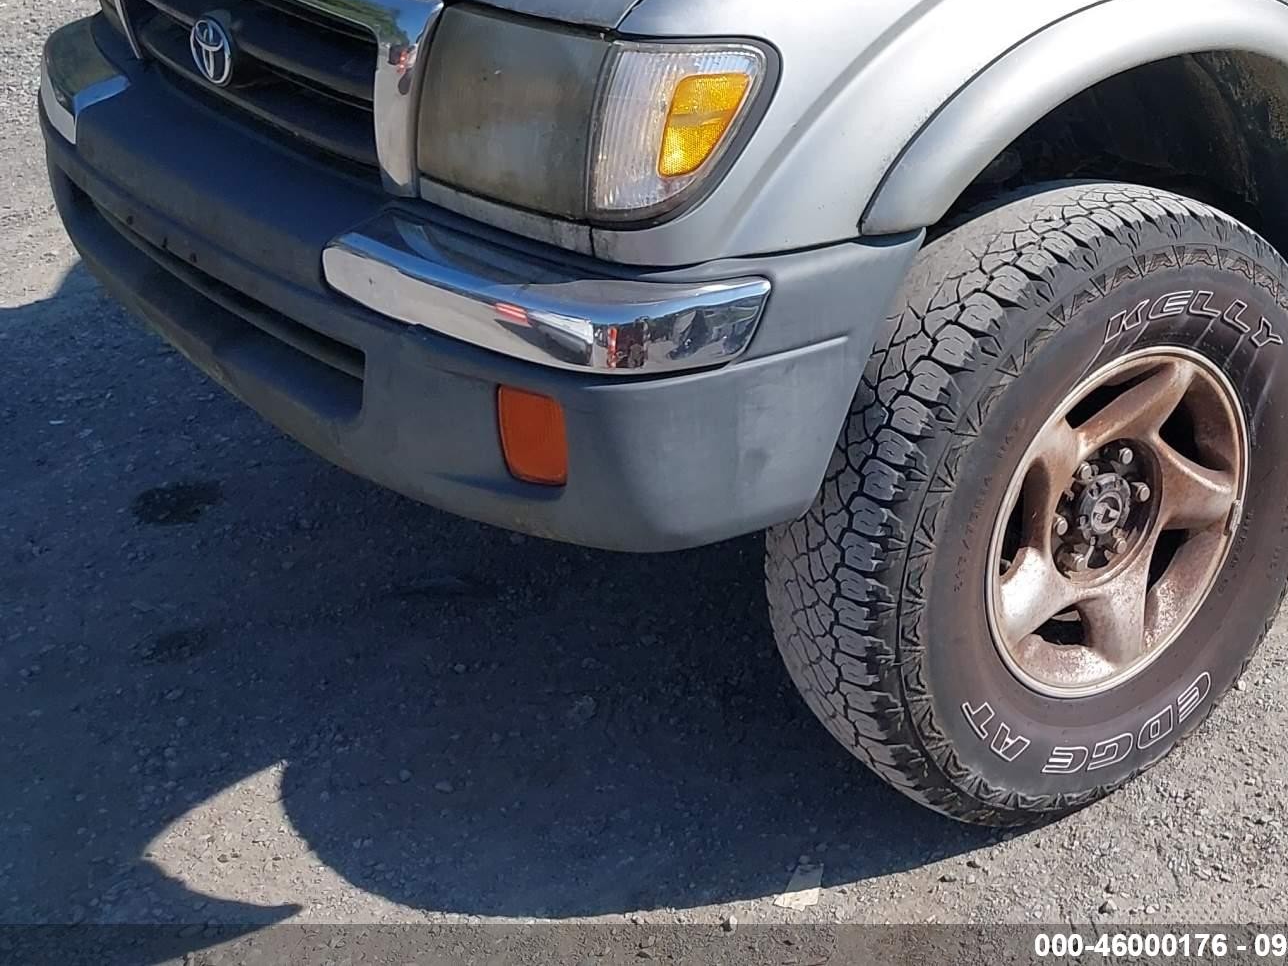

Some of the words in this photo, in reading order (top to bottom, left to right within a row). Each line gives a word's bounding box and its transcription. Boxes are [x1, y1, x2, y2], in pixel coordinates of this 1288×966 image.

[1104, 290, 1284, 347] KELLY
[961, 701, 1031, 762] AT
[1041, 671, 1212, 774] EDGE
